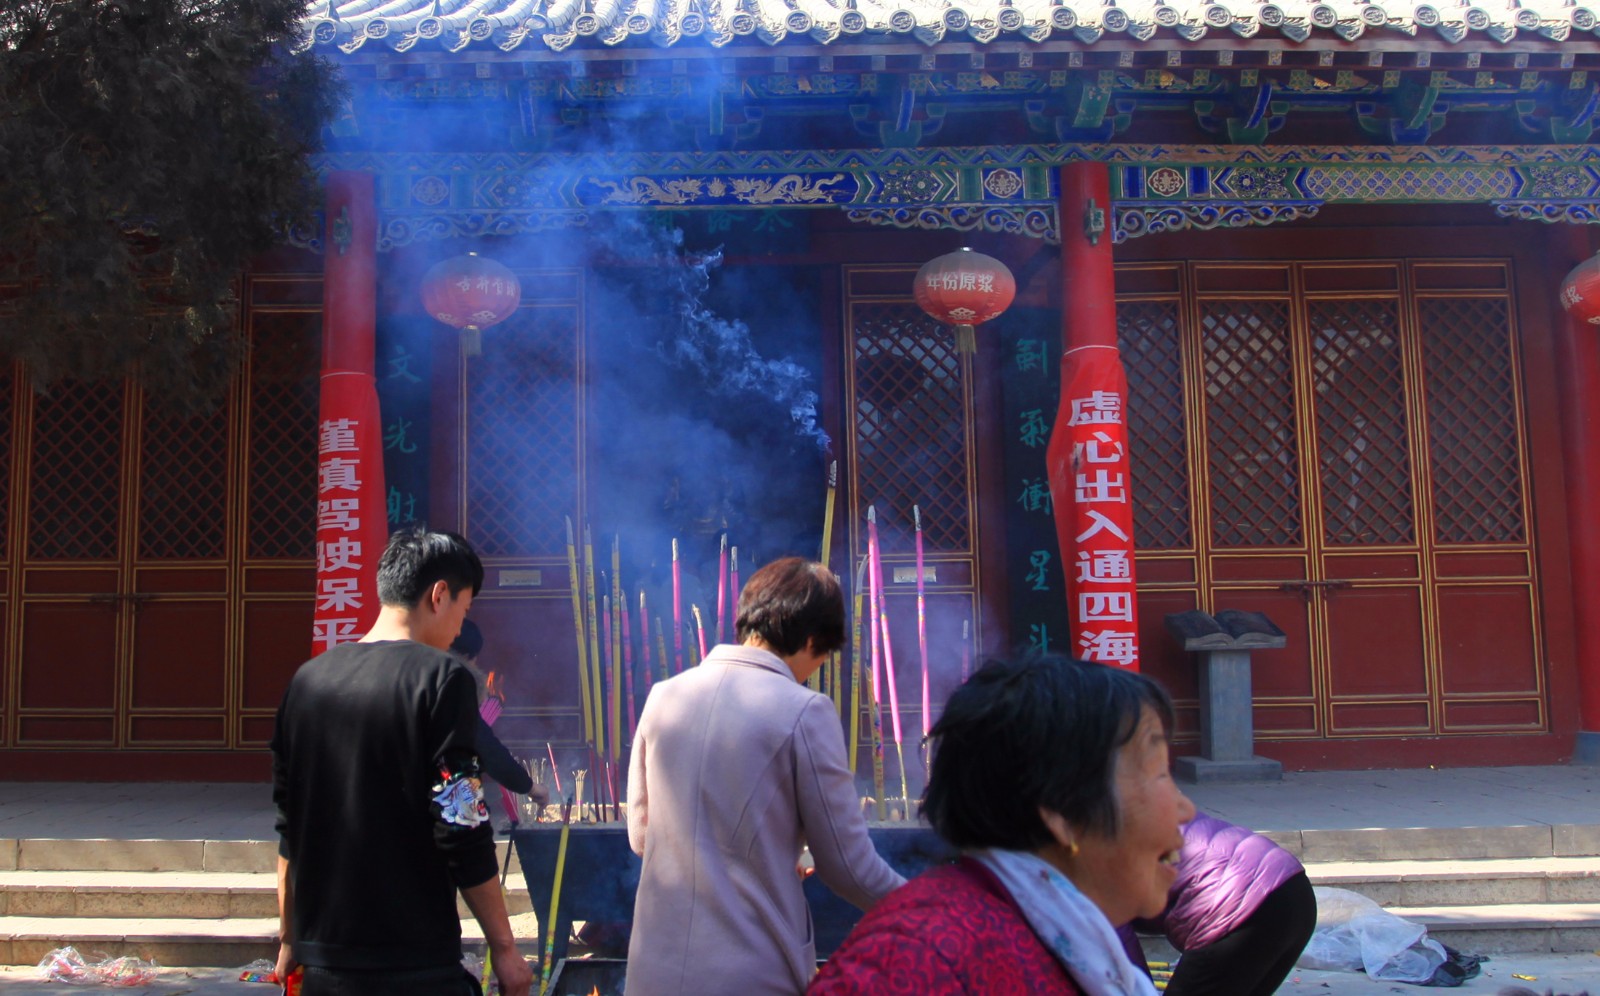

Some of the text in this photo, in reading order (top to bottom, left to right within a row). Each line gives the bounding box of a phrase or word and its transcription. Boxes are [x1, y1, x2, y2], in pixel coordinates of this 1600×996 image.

[927, 272, 993, 293] 年份原浆
[1067, 390, 1138, 665] 虚心出入通四海
